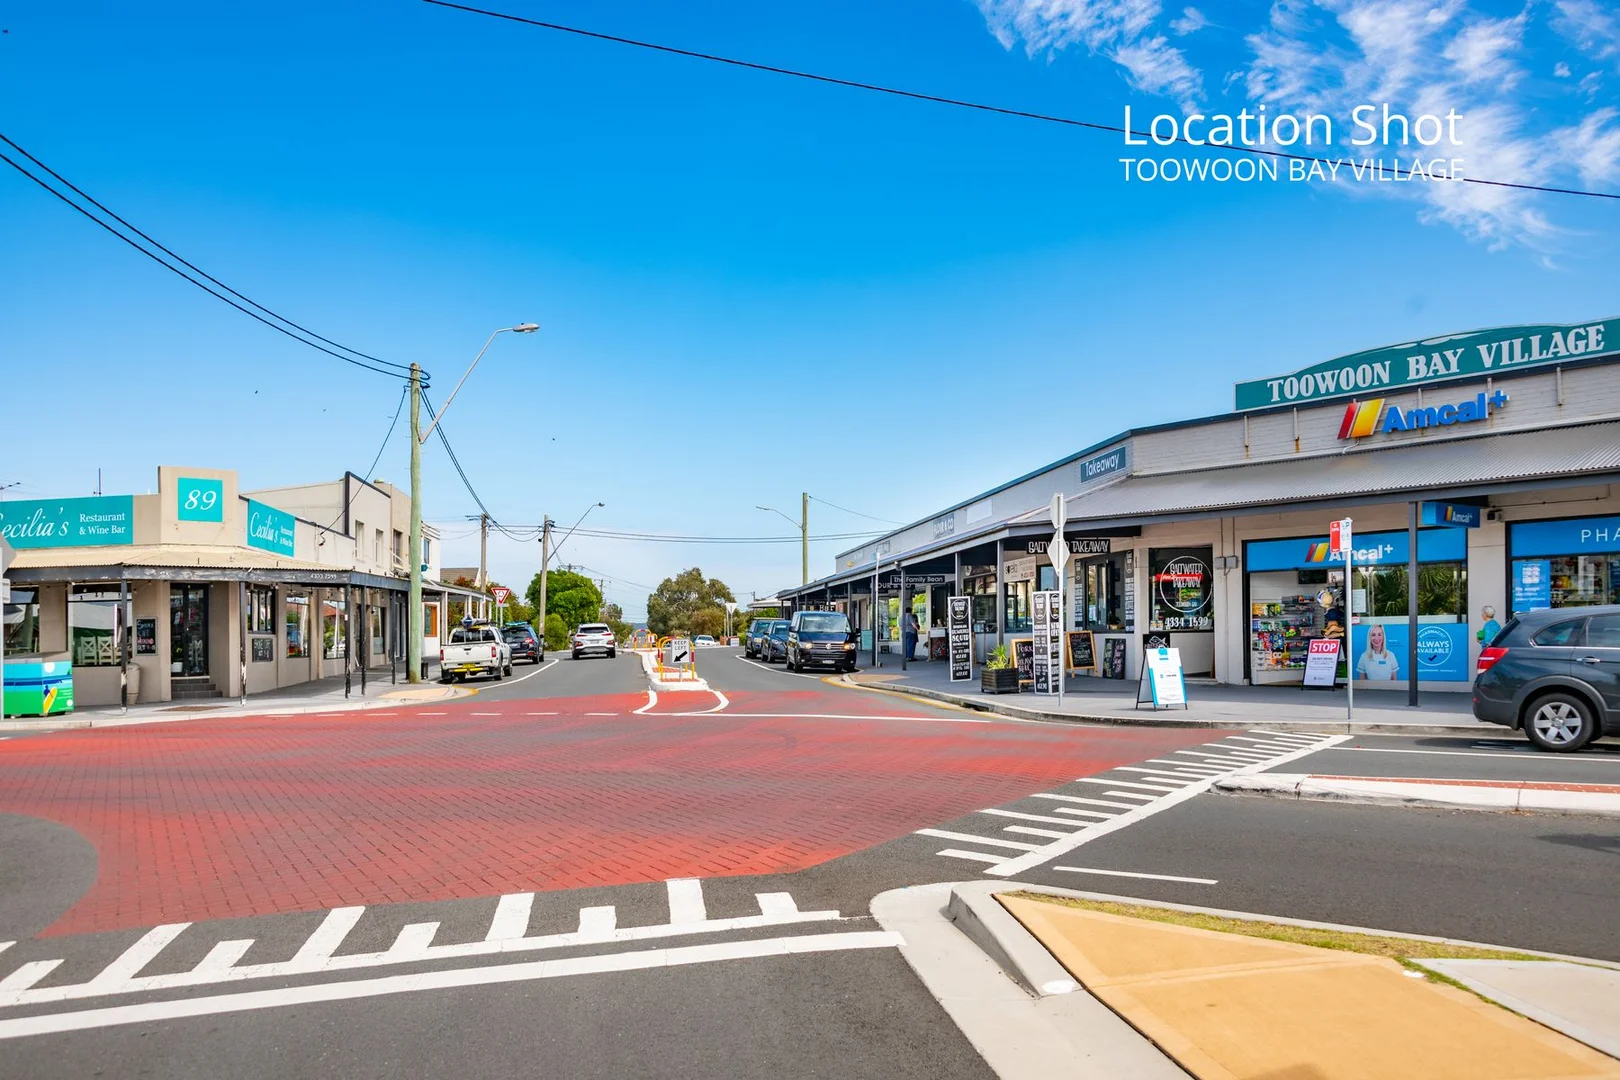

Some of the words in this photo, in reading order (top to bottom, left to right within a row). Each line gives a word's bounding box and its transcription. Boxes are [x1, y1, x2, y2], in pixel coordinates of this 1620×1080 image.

[1267, 360, 1392, 403] TOOWOON
[1406, 347, 1465, 381] BAY
[1476, 324, 1606, 369] VILLAGE
[1382, 389, 1511, 434] Amcal+
[1085, 453, 1120, 477] Takeaway
[184, 489, 217, 511] 89
[0, 506, 69, 538] ecilia's
[79, 512, 125, 523] Restaurant
[78, 525, 86, 535] &
[88, 524, 109, 535] Wine
[111, 524, 126, 534] Bar
[249, 511, 279, 543] Cecilia's
[1071, 540, 1109, 553] TAKEAWAY
[1169, 563, 1203, 575] SALTWATER
[905, 576, 926, 584] Family
[1164, 616, 1184, 628] 4334
[1189, 616, 1209, 628] 1599
[1311, 642, 1337, 652] STOP
[1417, 640, 1449, 648] ALWAYS
